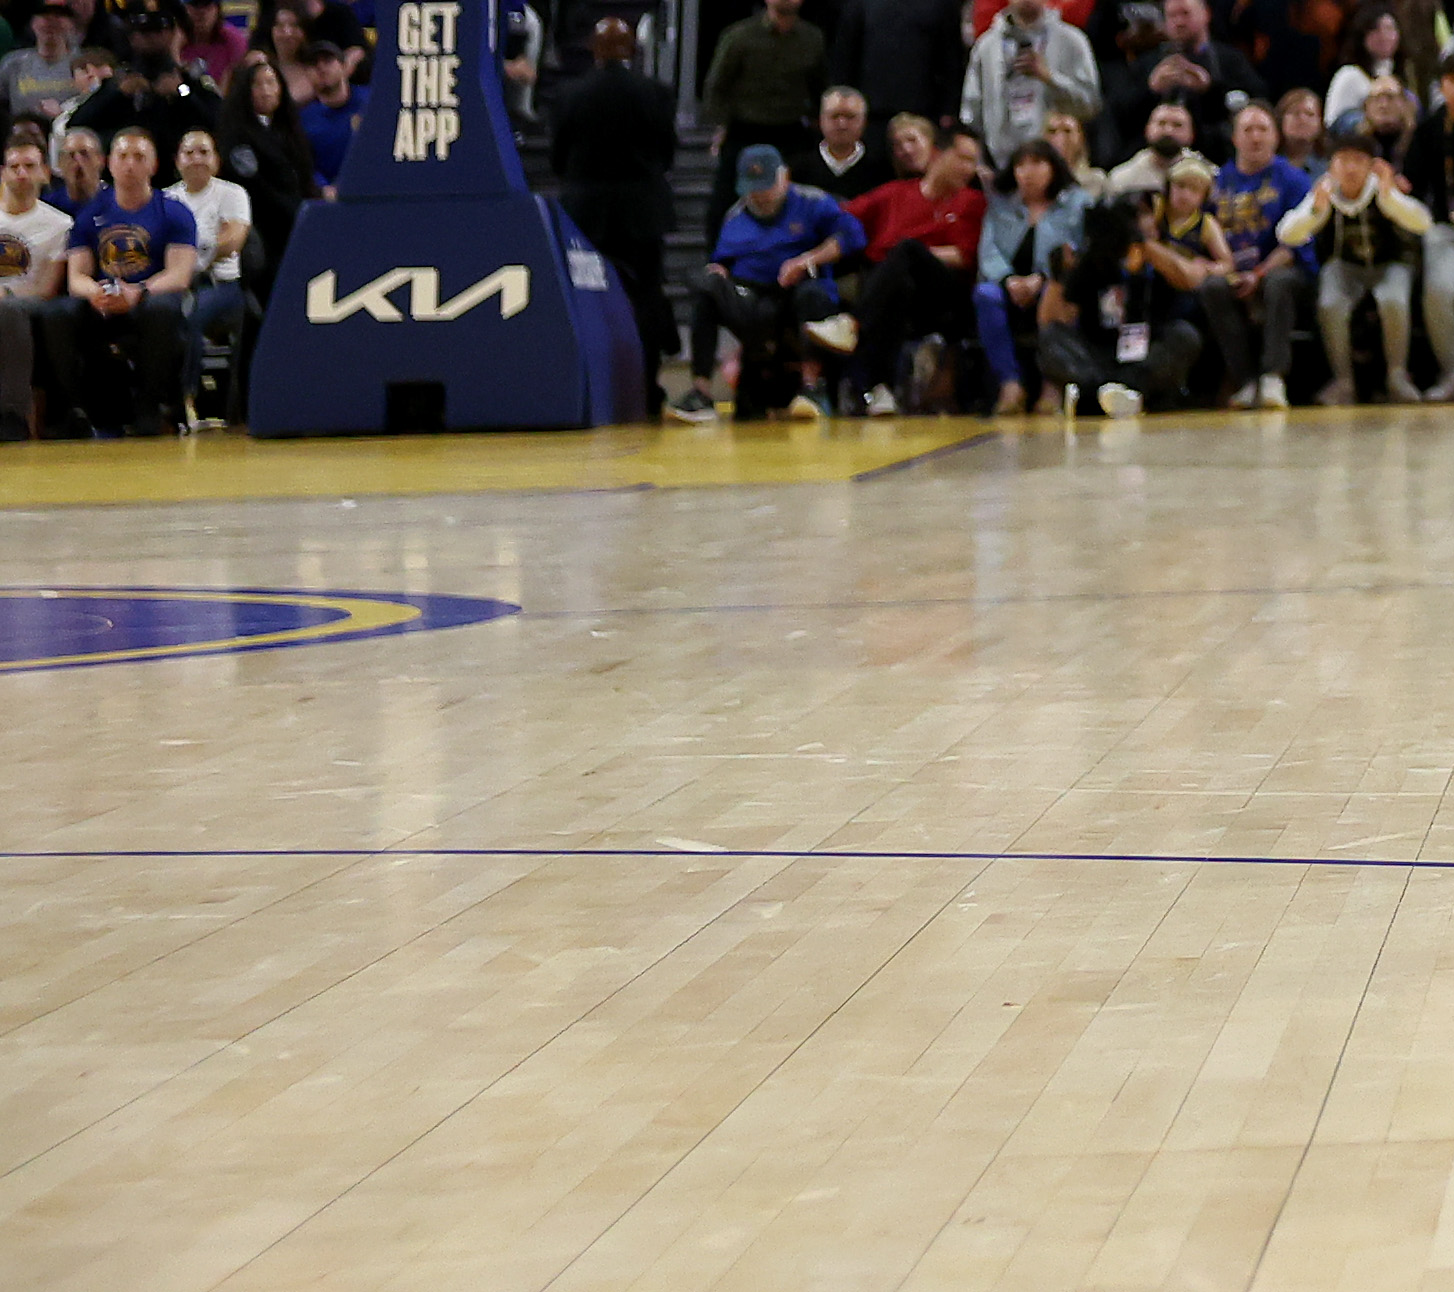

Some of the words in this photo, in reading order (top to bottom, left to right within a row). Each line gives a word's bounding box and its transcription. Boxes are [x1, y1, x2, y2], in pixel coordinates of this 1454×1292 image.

[398, 0, 460, 56] GET
[397, 53, 461, 110] THE
[393, 106, 461, 162] APP
